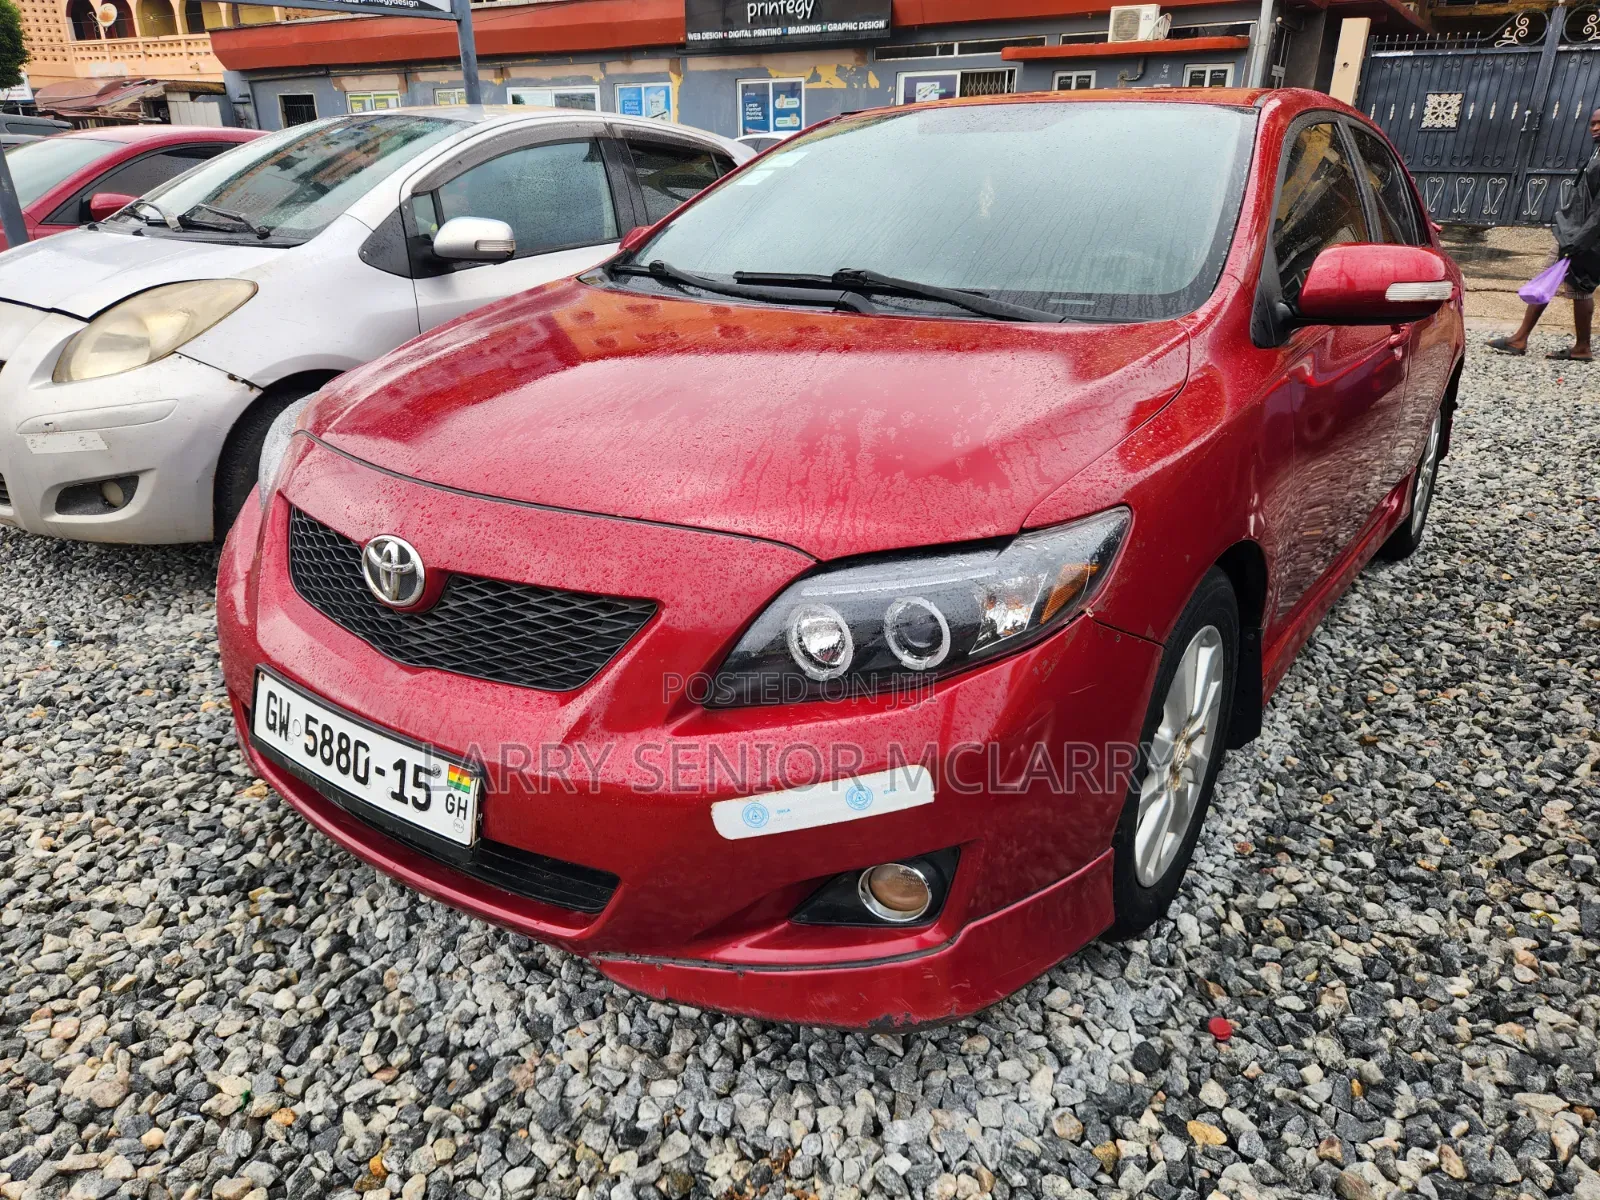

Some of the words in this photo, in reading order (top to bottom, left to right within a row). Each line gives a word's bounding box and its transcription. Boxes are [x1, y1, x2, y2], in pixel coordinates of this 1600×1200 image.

[747, 0, 815, 23] printegy
[688, 31, 701, 41] WEB
[702, 31, 723, 40] DESIGN
[728, 29, 751, 39] DIGITAL
[753, 27, 782, 37] PRINTING
[788, 24, 822, 34] BRANDING
[828, 22, 857, 32] GRAPHIC
[859, 20, 885, 30] DESIGN
[266, 690, 291, 741] GW
[304, 713, 432, 812] 5880-15
[445, 793, 468, 820] GH
